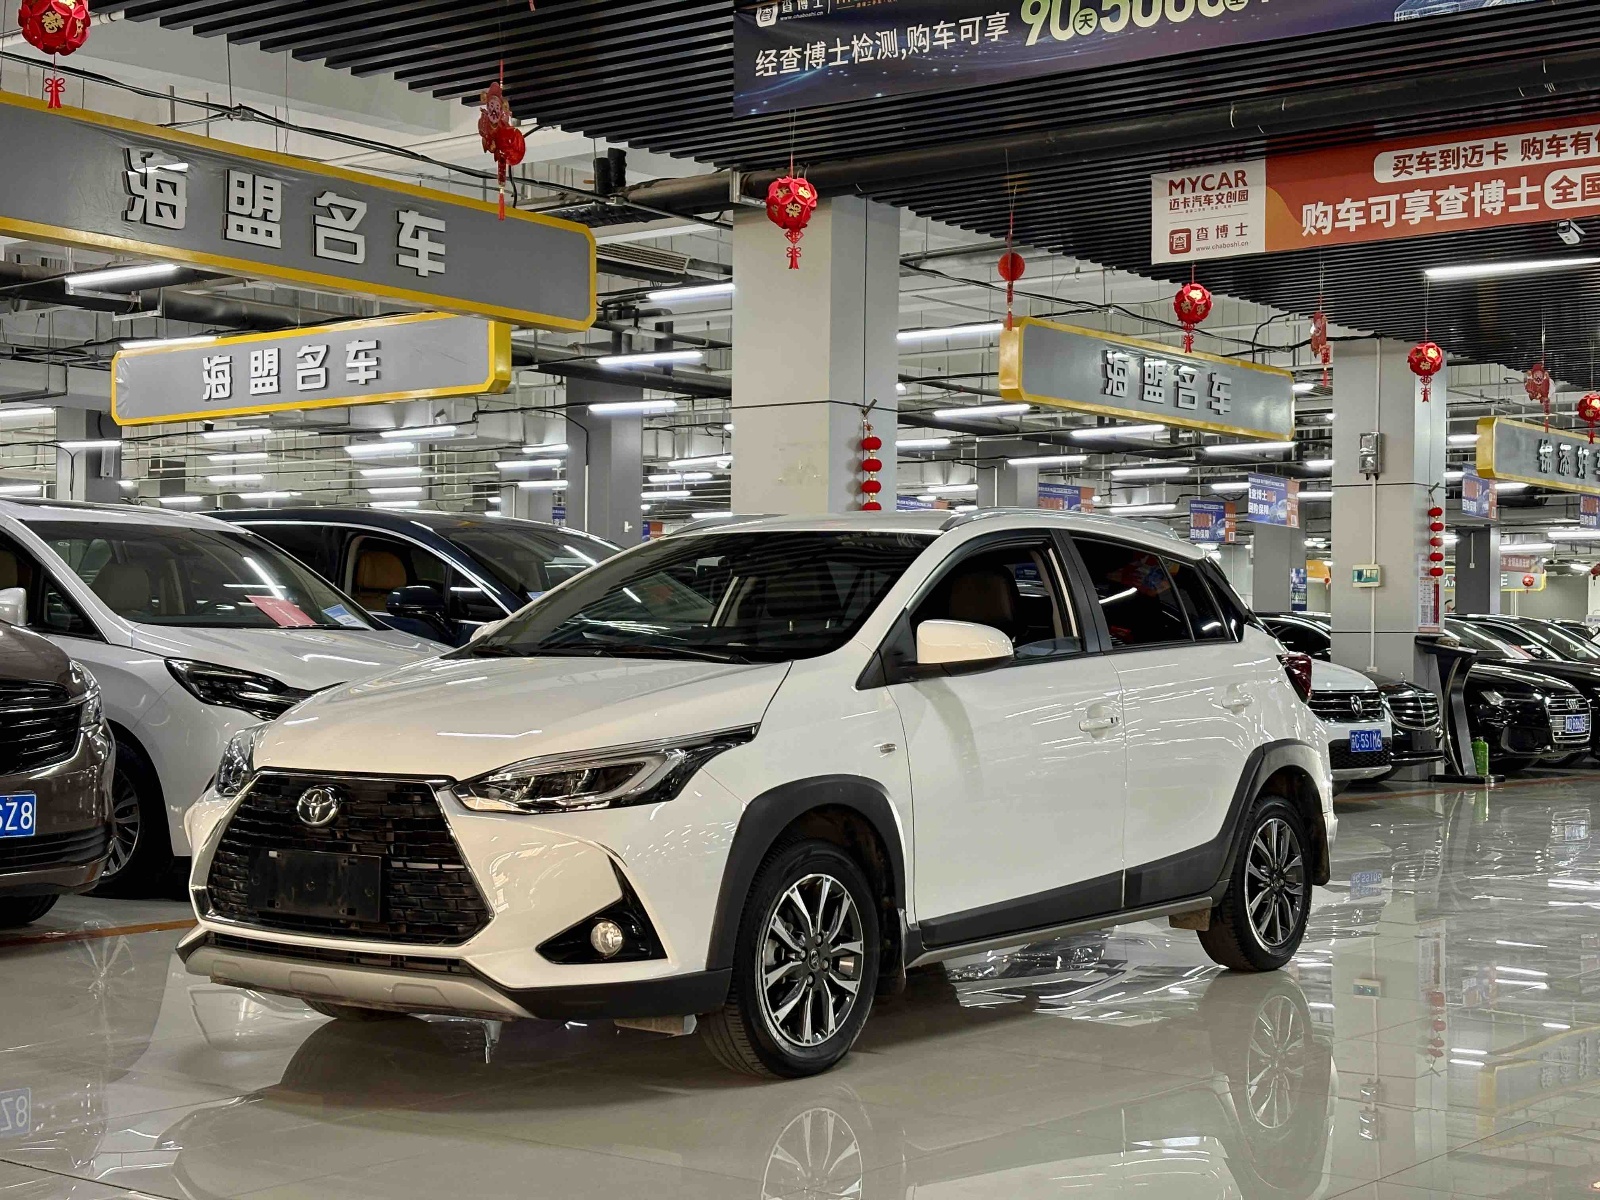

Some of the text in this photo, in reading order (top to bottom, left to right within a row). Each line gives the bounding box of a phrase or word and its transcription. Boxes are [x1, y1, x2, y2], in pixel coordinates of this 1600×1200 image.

[1392, 131, 1600, 178] 买车到迈卡 购车有
[1168, 170, 1248, 196] MYCAR
[1169, 189, 1249, 211] 迈卡汽车文创园
[123, 148, 446, 278] 海盟名车
[1196, 222, 1249, 242] 查博士
[1196, 241, 1249, 252] www.chaboshi.cn
[203, 339, 381, 401] 海盟名车
[1102, 349, 1232, 415] 海盟名车
